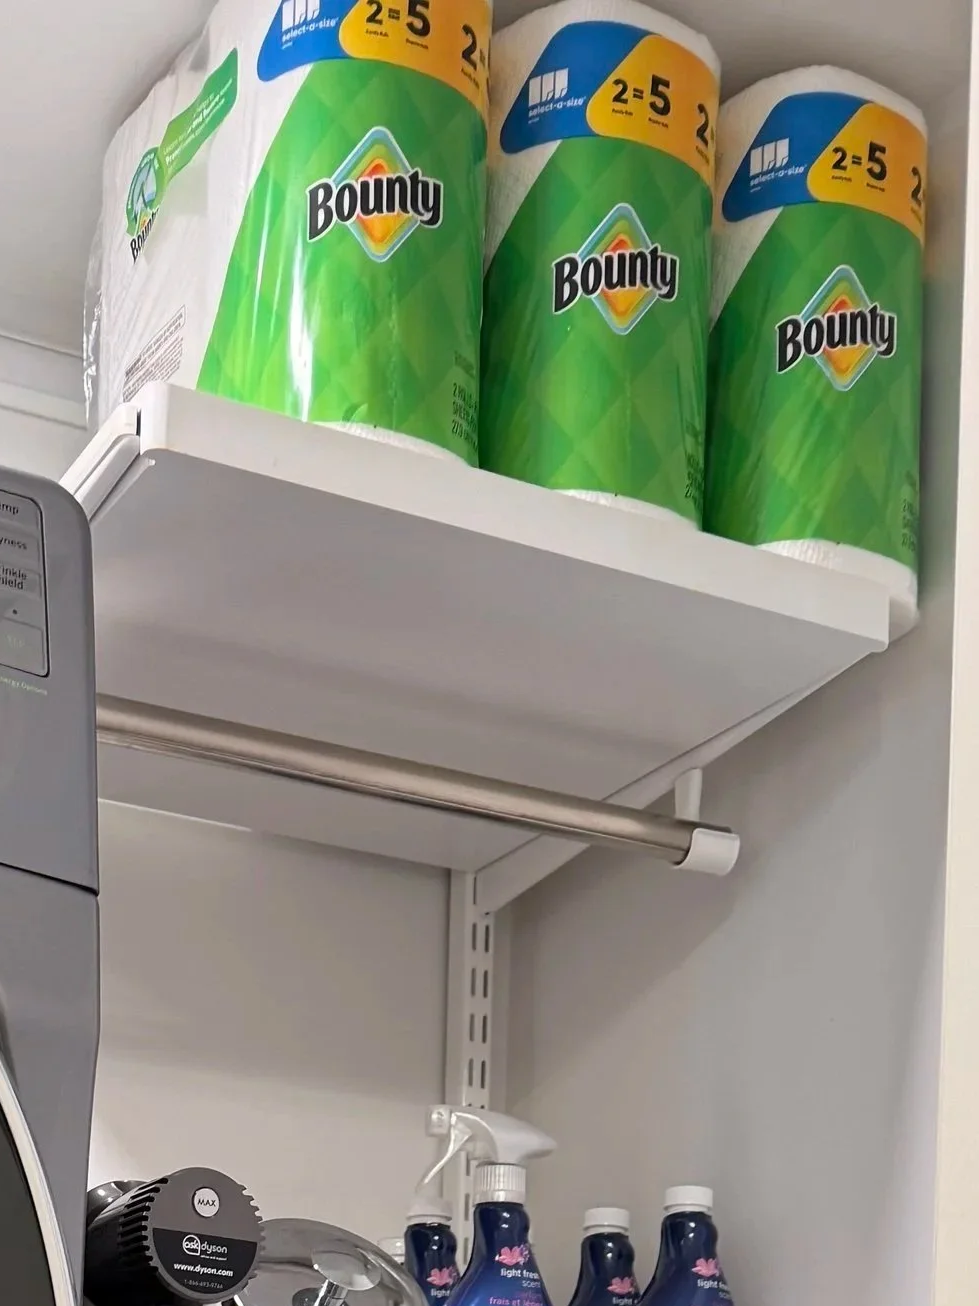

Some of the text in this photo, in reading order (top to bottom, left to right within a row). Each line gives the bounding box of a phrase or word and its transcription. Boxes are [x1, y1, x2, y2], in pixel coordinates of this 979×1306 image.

[308, 168, 443, 241] Bounty
[552, 243, 679, 314] Bounty
[776, 305, 897, 373] Bounty
[197, 1198, 217, 1207] MAX
[184, 1239, 228, 1254] ask dyson
[173, 1263, 234, 1277] www.dyson.com
[500, 1268, 521, 1278] light
[697, 1278, 718, 1290] light
[489, 1296, 510, 1306] frais
